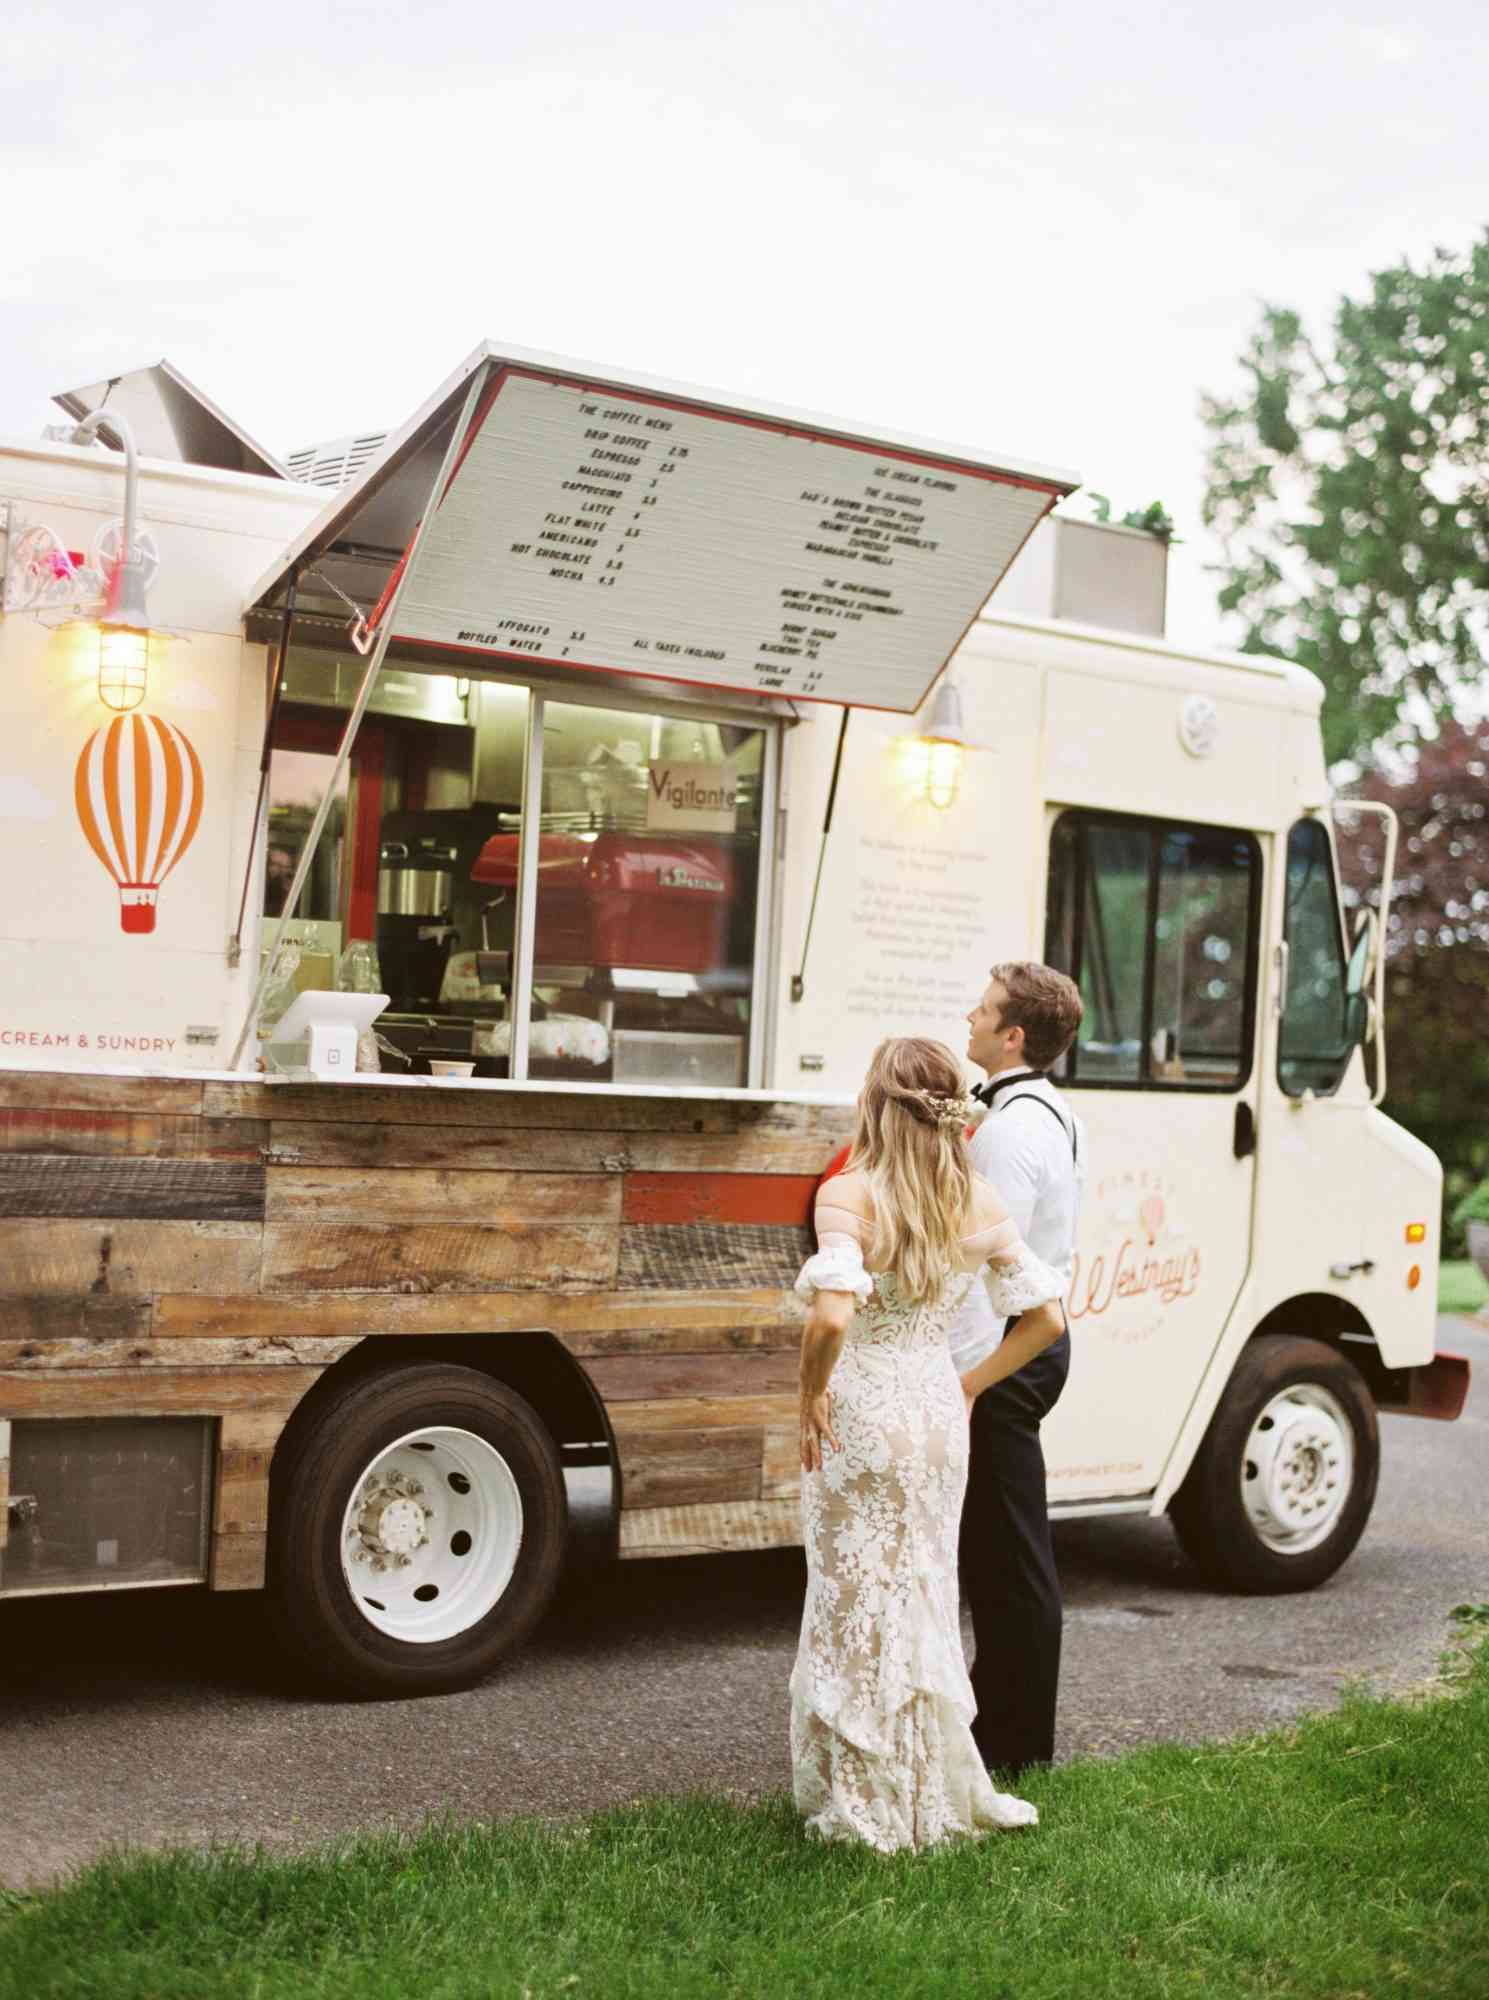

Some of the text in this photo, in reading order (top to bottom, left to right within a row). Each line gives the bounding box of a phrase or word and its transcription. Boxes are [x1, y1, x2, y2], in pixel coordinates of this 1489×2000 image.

[578, 403, 673, 432] THE COFFEE MENU
[584, 429, 610, 440] DRIP
[612, 435, 651, 450] COFFEE
[591, 448, 641, 466] ESPRESSO
[578, 465, 632, 483] MACCHIATO
[561, 481, 624, 499] CAPPUCCINO
[580, 502, 616, 516] LATTE
[544, 512, 572, 526] FLAT
[574, 519, 608, 532] WHITE
[538, 531, 598, 548] AMERICANO
[510, 543, 532, 554] HOT
[536, 548, 593, 566] CHOCOLATE
[549, 568, 584, 582] MOCHA
[497, 620, 550, 636] AFFOGATO
[457, 630, 498, 645] BOTTLED
[509, 638, 542, 652] WATER
[633, 639, 726, 661] ALL TAXES INCLUDED
[648, 769, 736, 809] Vigilante
[0, 1031, 177, 1051] CREAM & SUNDRY
